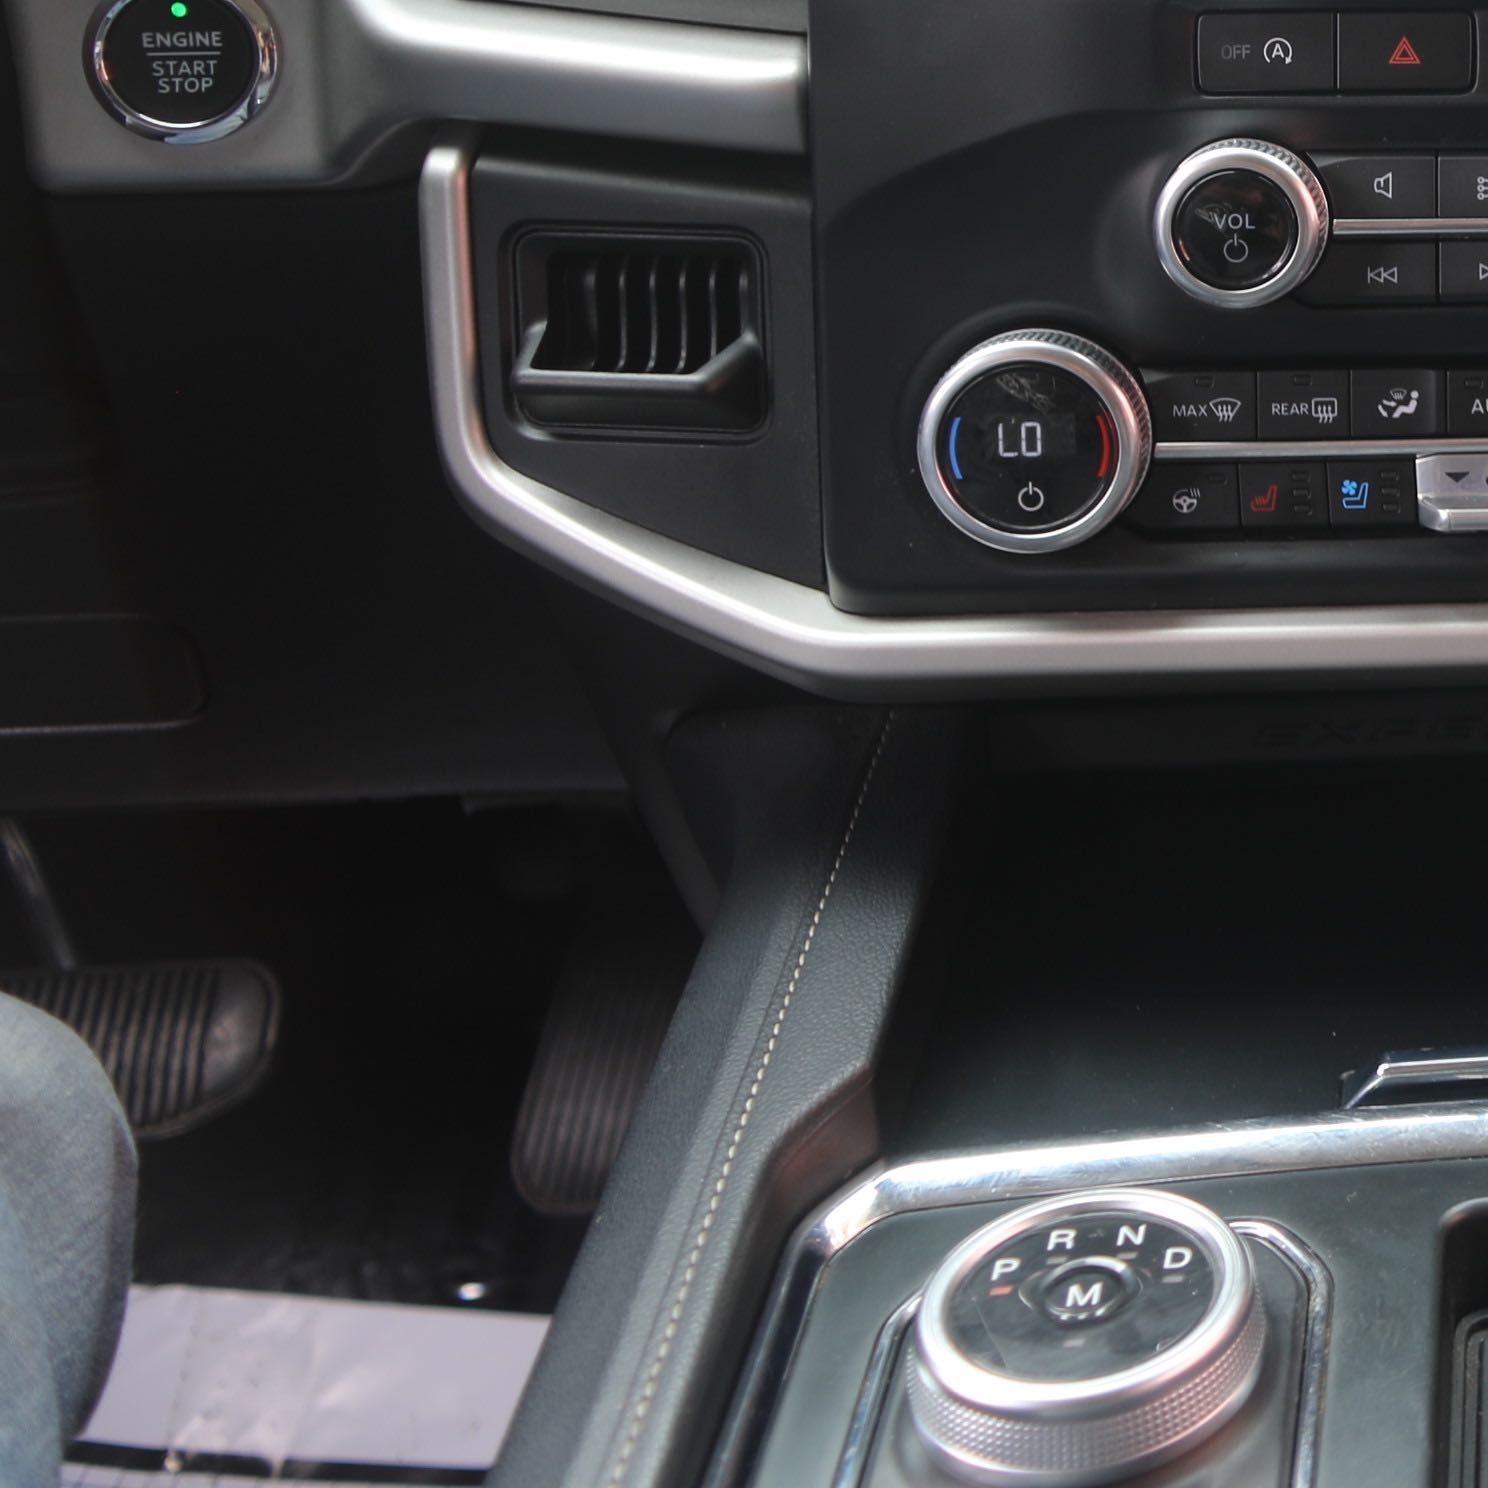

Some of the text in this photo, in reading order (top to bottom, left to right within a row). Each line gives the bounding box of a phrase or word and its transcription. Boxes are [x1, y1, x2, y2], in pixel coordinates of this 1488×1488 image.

[142, 31, 223, 49] ENGINE
[1220, 43, 1251, 61] OFF
[152, 59, 218, 78] START
[158, 77, 213, 94] STOP
[1216, 213, 1256, 231] VOL
[1172, 403, 1208, 418] MAX
[1271, 402, 1309, 417] REAR
[990, 1223, 1193, 1282] P R N D
[1064, 1282, 1104, 1309] M
